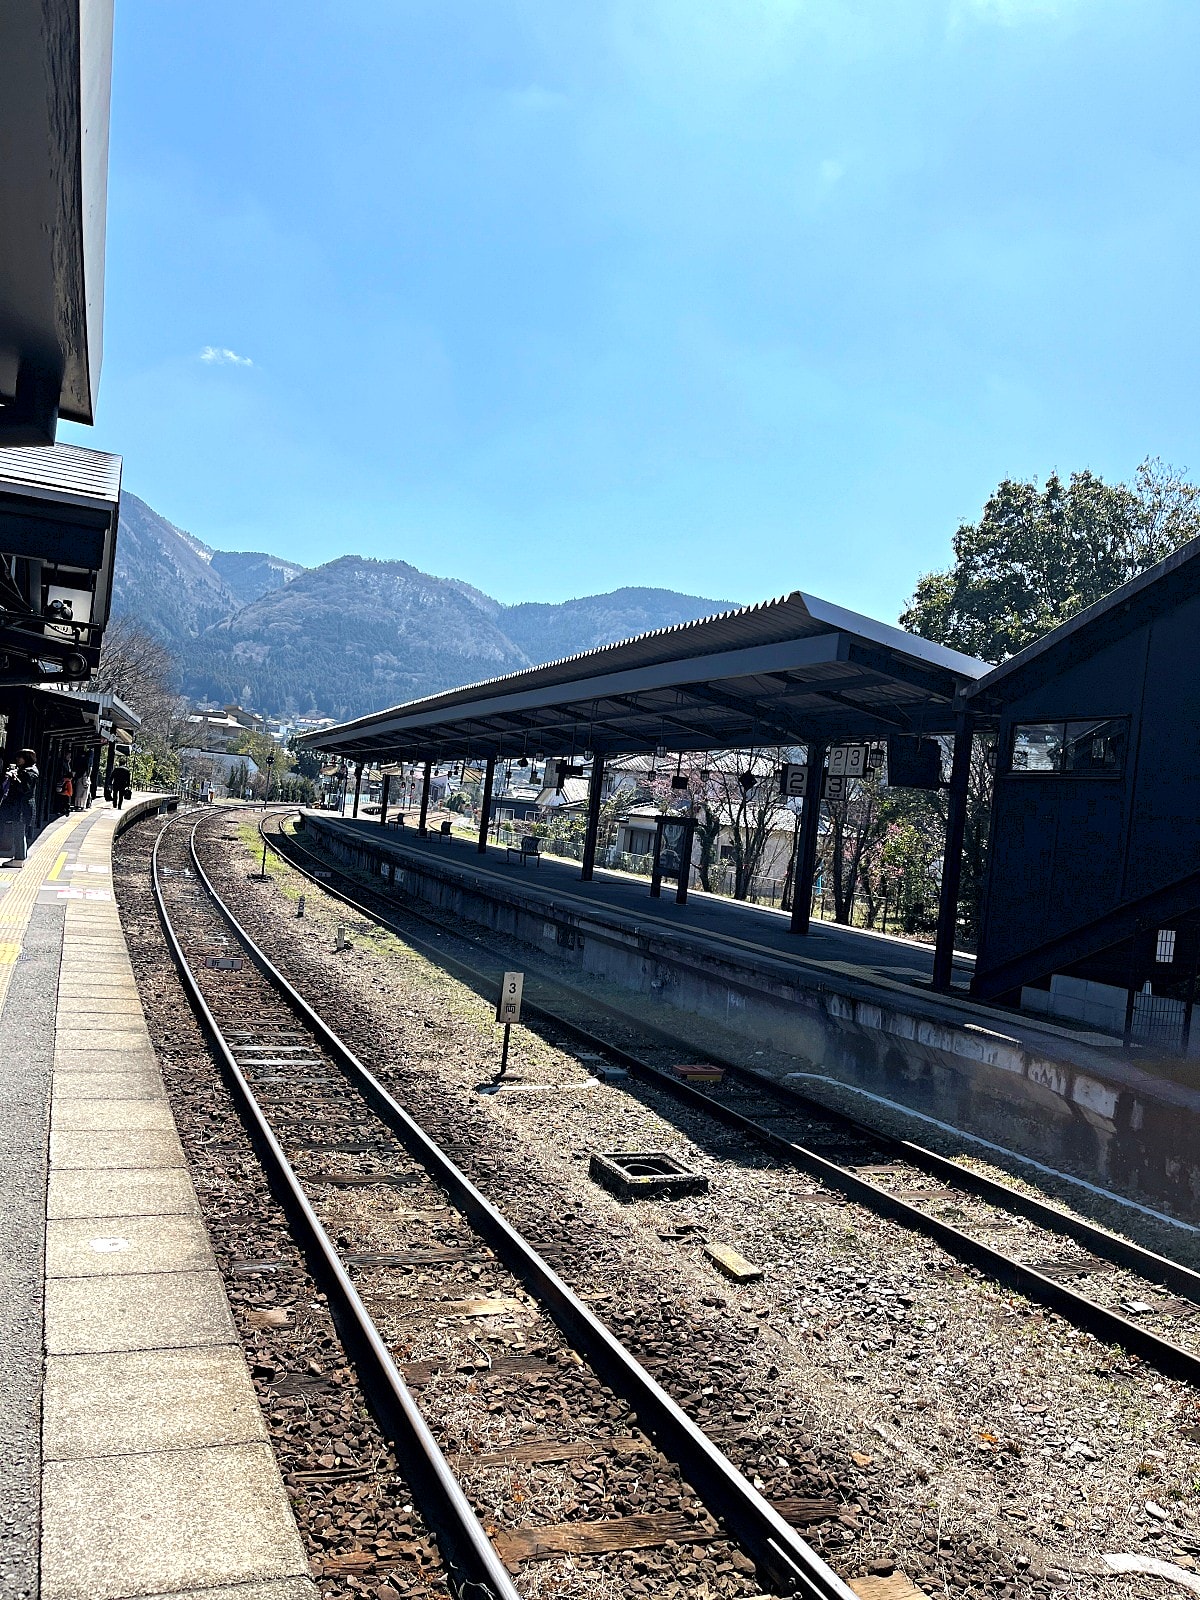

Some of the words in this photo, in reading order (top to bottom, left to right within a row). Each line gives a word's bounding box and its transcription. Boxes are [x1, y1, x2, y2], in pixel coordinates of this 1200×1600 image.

[834, 750, 843, 766] 2
[850, 750, 860, 766] 3
[790, 772, 805, 789] 2
[828, 777, 843, 792] 3
